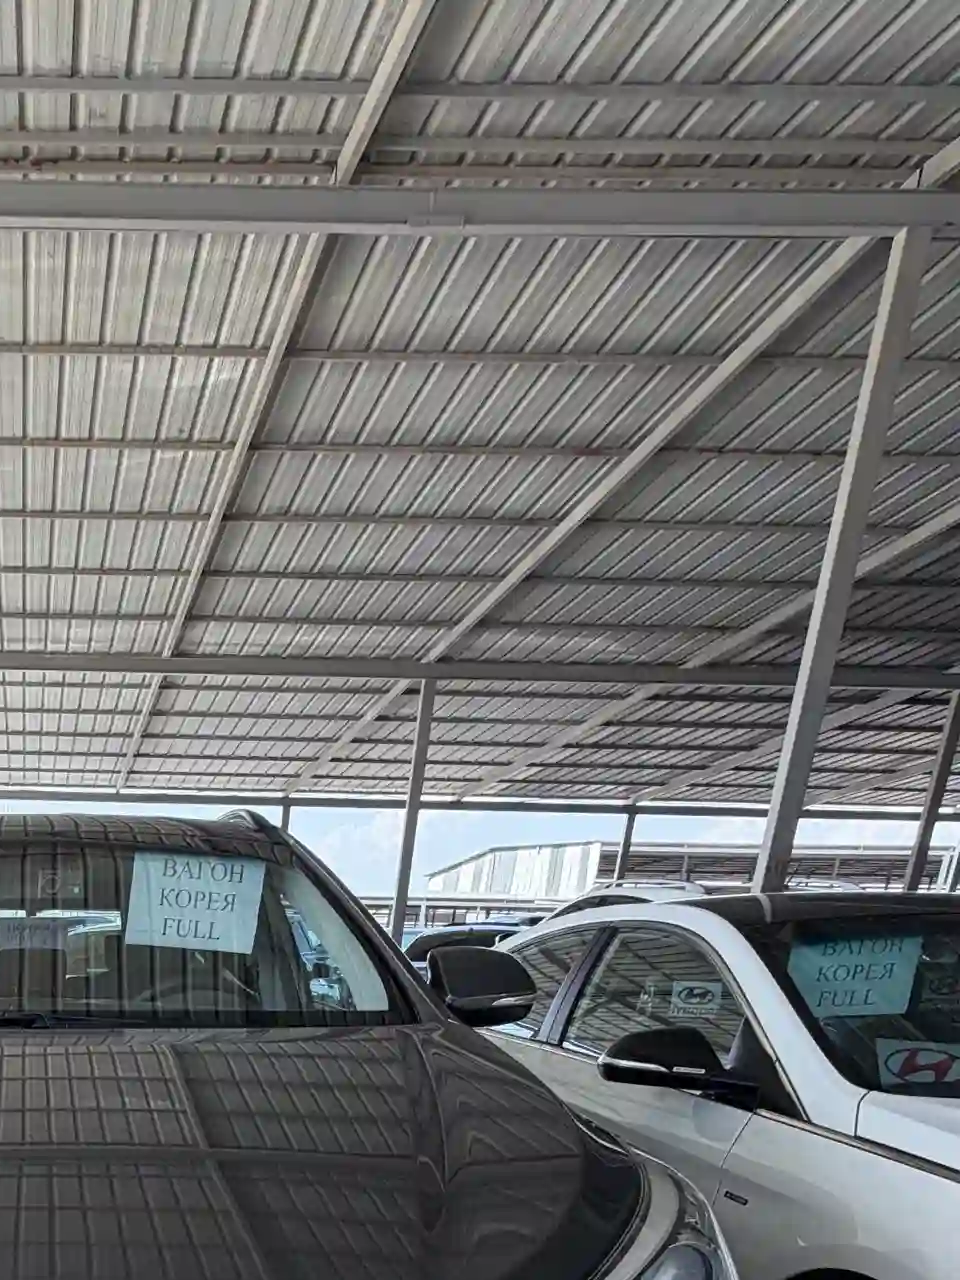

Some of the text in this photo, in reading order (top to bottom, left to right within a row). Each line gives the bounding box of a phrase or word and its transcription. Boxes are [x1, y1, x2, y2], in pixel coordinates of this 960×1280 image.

[161, 857, 245, 884] ВАГОН
[158, 887, 237, 912] КОРЕЯ
[161, 917, 220, 940] FULL
[815, 962, 897, 983] КОРЕЯ
[815, 988, 877, 1008] FULL
